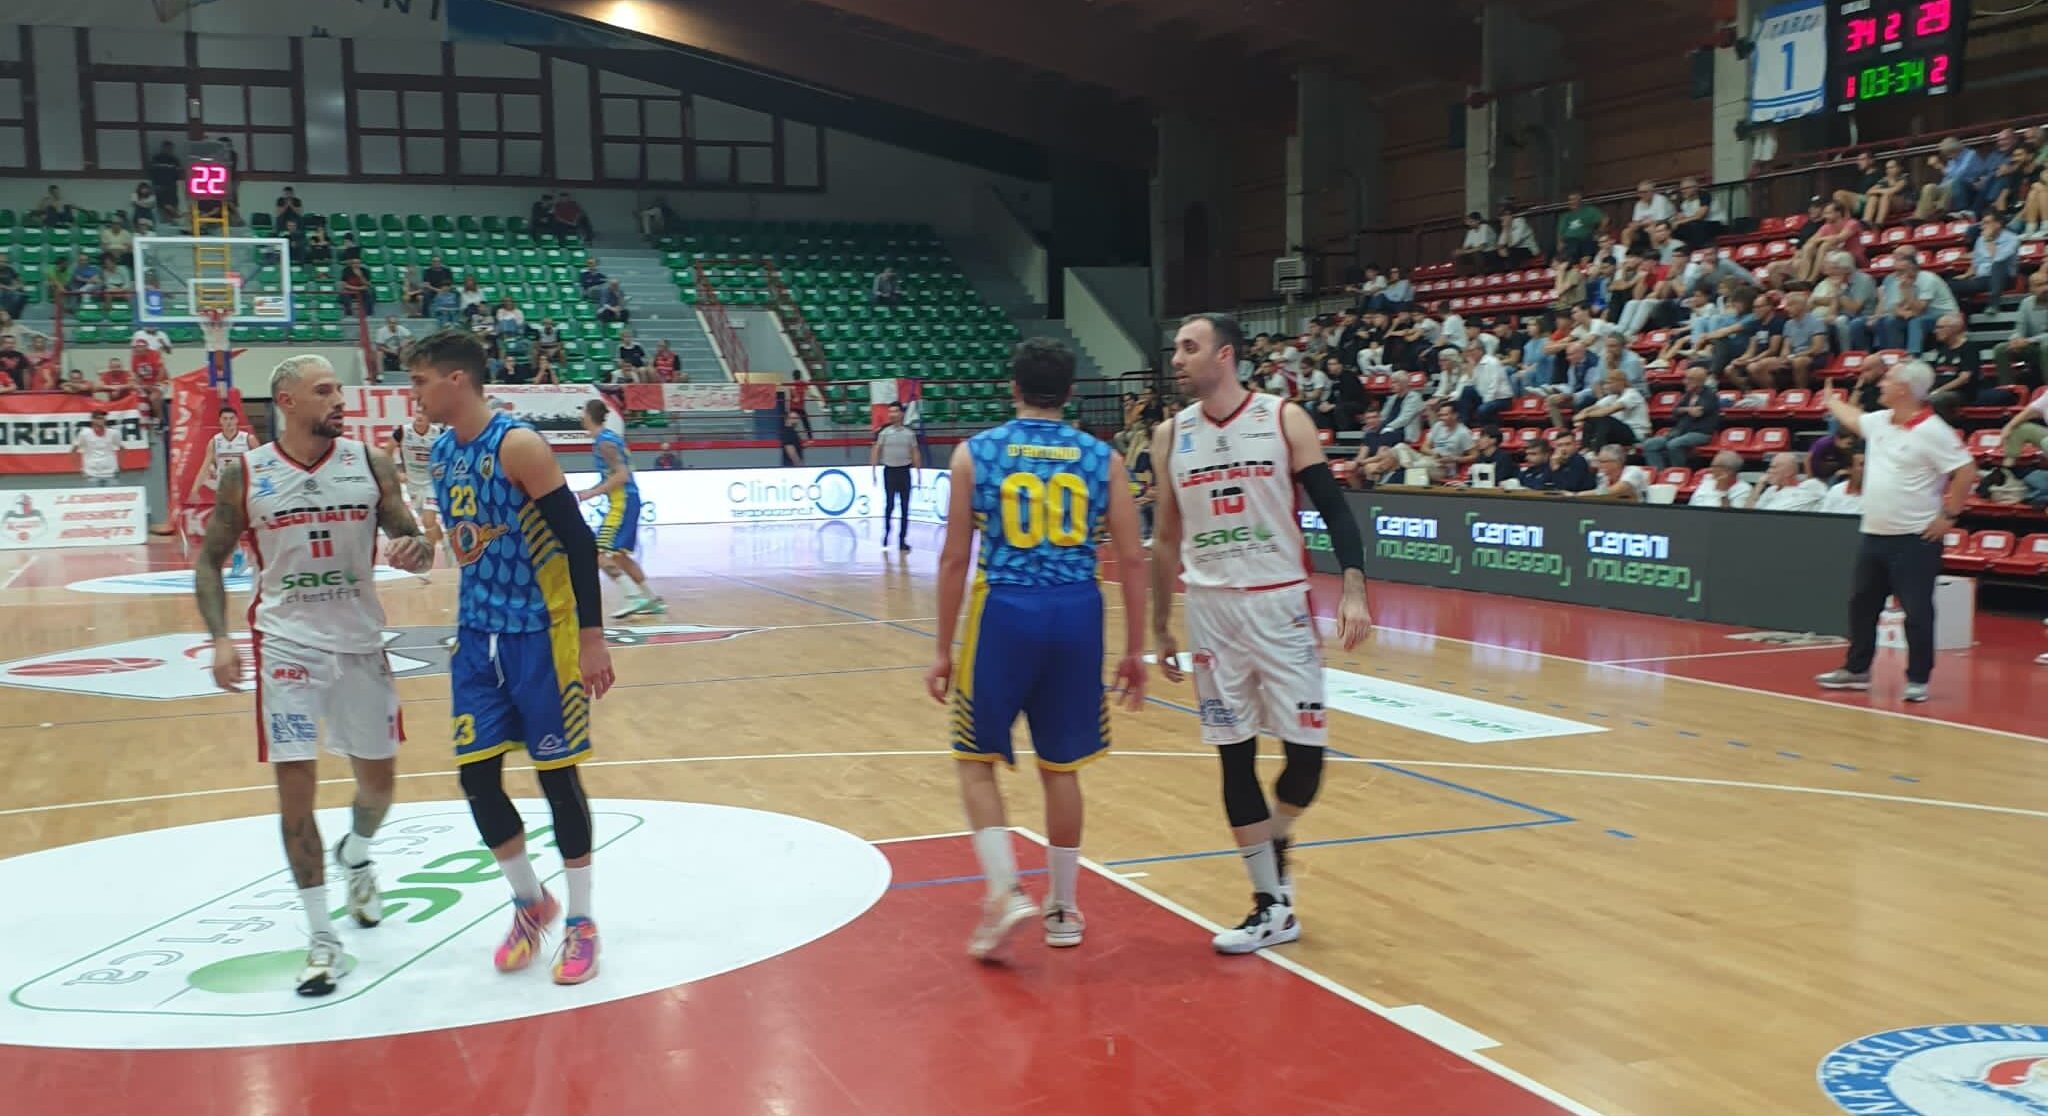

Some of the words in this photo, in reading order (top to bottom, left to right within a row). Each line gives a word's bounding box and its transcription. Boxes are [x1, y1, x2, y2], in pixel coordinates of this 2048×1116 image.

[1845, 18, 1877, 52] 34
[1884, 11, 1903, 41] 2
[1782, 41, 1796, 90] 1
[1860, 58, 1925, 100] 03:34
[1930, 54, 1949, 84] 2
[191, 166, 226, 194] 22
[449, 484, 478, 517] 23
[727, 478, 822, 504] Clinica
[1210, 486, 1246, 516] 10
[1001, 472, 1089, 549] 00
[309, 530, 333, 558] 11
[453, 713, 475, 746] 3
